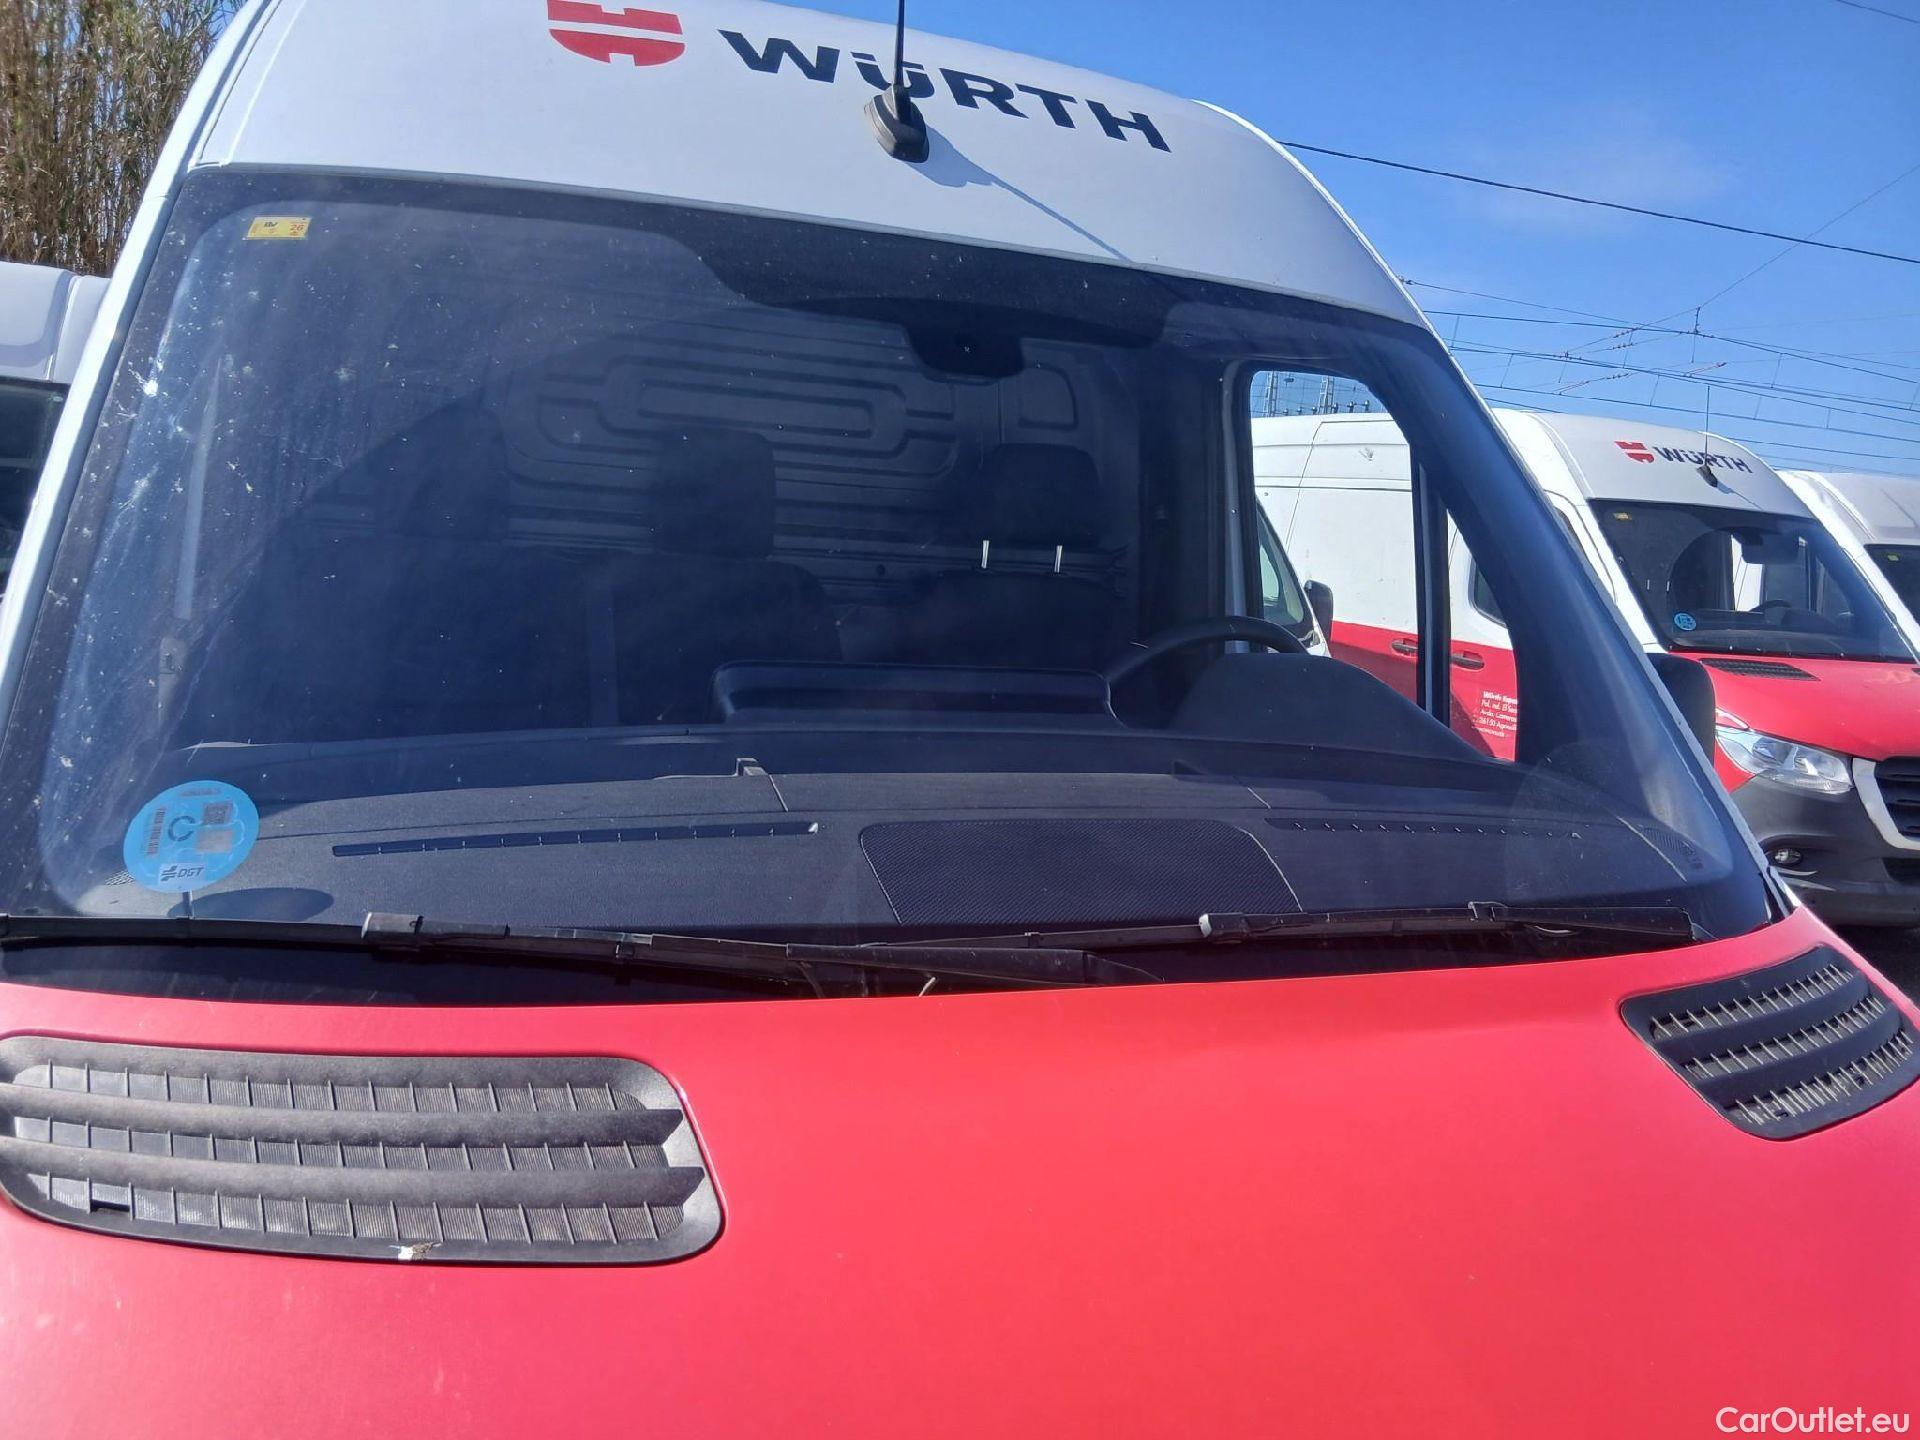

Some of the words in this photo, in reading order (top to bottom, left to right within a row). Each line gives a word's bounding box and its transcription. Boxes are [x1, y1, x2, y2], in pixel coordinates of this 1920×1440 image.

[718, 28, 1171, 154] WÜRTH
[1652, 446, 1753, 474] WÜRTH
[168, 815, 195, 842] C
